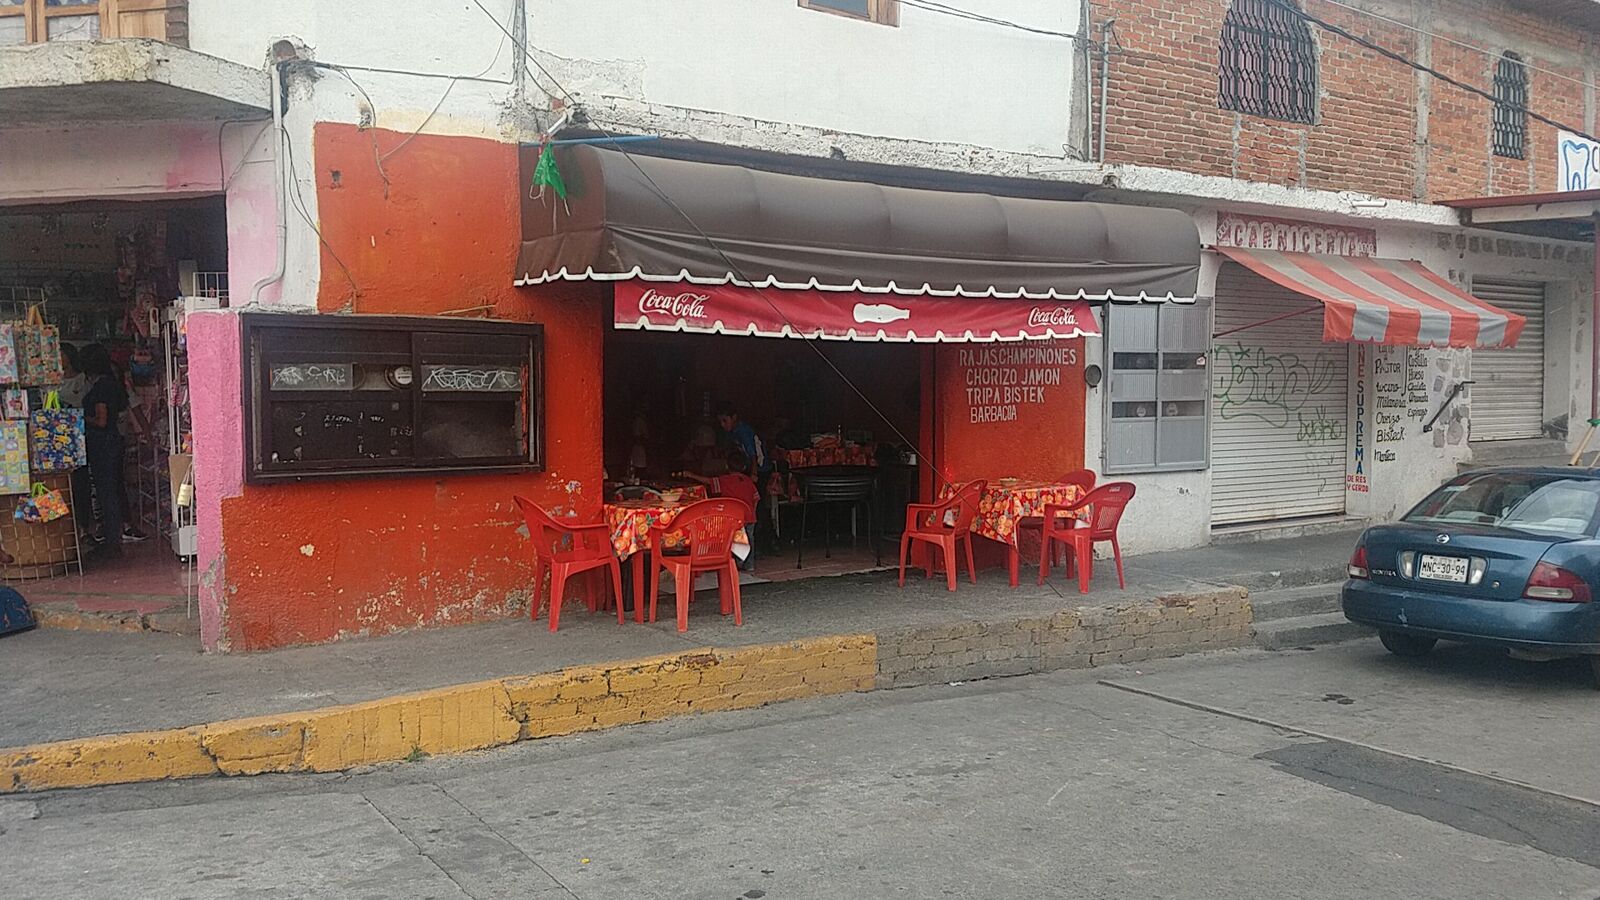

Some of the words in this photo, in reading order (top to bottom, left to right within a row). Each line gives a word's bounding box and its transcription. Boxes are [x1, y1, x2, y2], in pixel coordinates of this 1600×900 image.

[638, 288, 710, 318] Coca-Cola
[1027, 306, 1079, 327] Coca-Cola
[966, 368, 1017, 386] CHORIZO
[1021, 367, 1060, 385] JAMON
[966, 388, 1001, 406] TRIPA
[1004, 386, 1045, 404] BISTEK
[970, 405, 1017, 424] BARBACOA
[1355, 380, 1365, 475] SUPREMA
